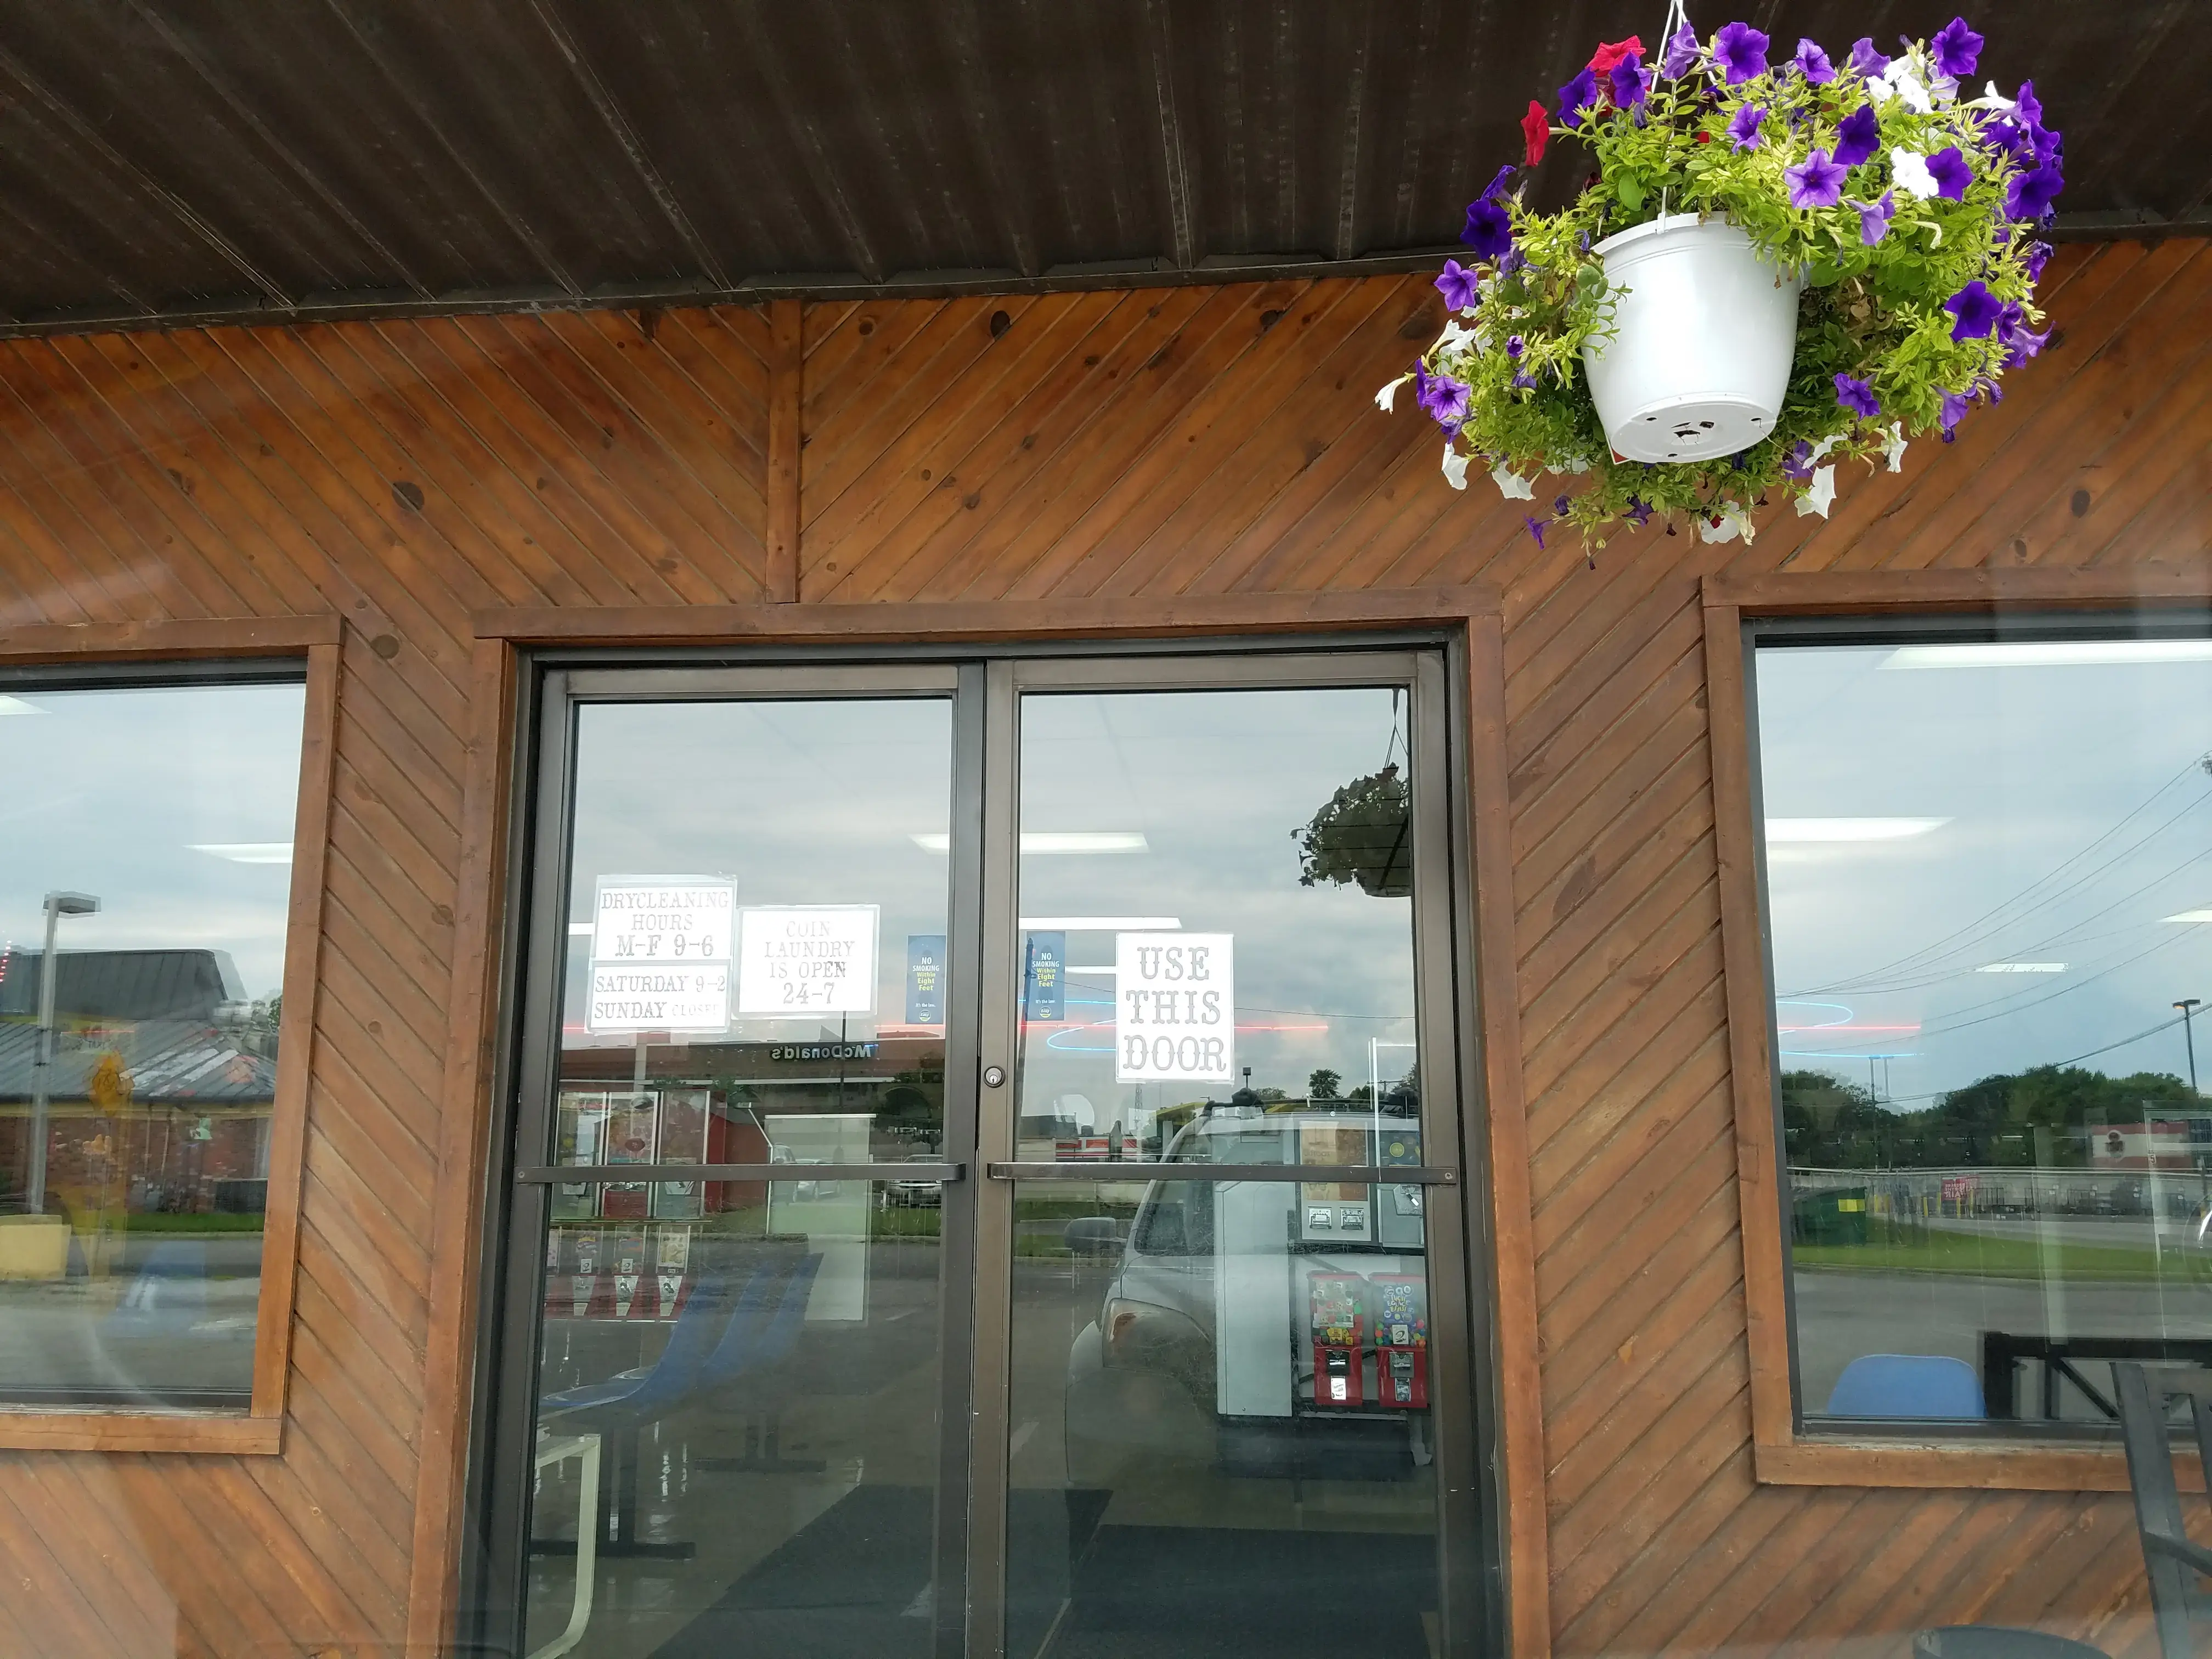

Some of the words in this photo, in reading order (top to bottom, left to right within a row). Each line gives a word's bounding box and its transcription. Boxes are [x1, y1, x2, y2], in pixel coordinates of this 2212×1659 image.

[601, 892, 729, 909] DRYCLEANING
[631, 914, 693, 930] HOURS
[786, 921, 830, 937] COIN
[615, 934, 662, 956] M-F
[674, 934, 714, 956] 9-6
[764, 941, 855, 958] LAUNDRY
[1041, 952, 1052, 961] NO
[1137, 946, 1209, 981] USE
[770, 962, 787, 979] IS
[799, 961, 847, 978] OPEN
[1037, 973, 1055, 981] Eight
[595, 975, 689, 992] SATURDAY
[783, 982, 834, 1004] 24-7
[595, 1002, 667, 1019] SUNDAY
[1126, 990, 1221, 1025] THIS
[1122, 1035, 1227, 1071] DOOR
